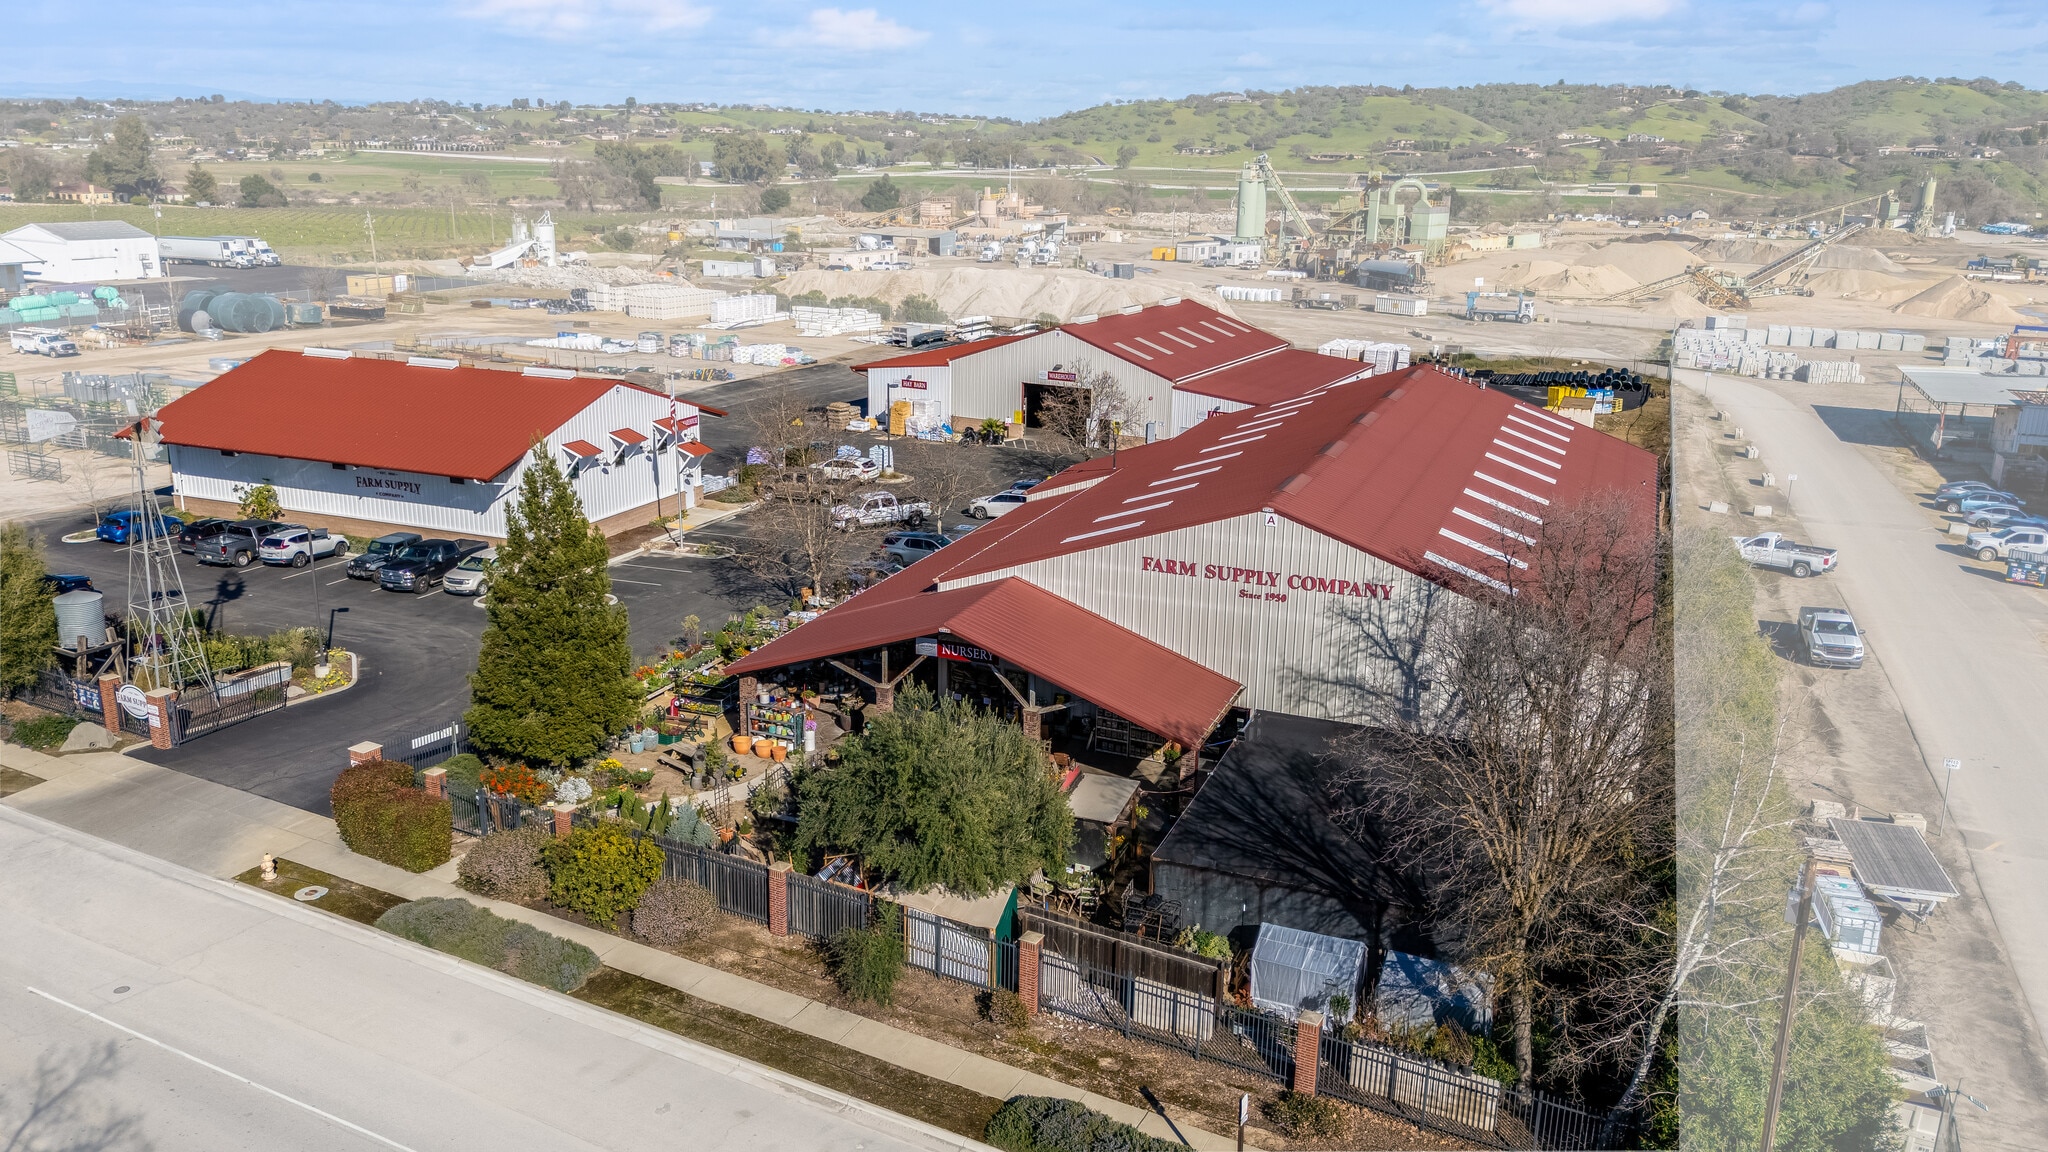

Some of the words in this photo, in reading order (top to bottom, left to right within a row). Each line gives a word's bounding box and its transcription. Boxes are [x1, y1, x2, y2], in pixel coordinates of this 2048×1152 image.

[1048, 372, 1076, 381] WAREHOUSE
[913, 381, 926, 389] BARN
[356, 476, 382, 488] FARM
[385, 479, 421, 495] SUPPLY
[1266, 515, 1275, 525] A
[1141, 556, 1197, 577] FARM
[1204, 563, 1281, 588] SUPPLY
[1287, 573, 1395, 601] COMPANY
[1238, 588, 1262, 600] Since
[1264, 592, 1287, 603] 1950
[942, 643, 993, 661] NURSERY
